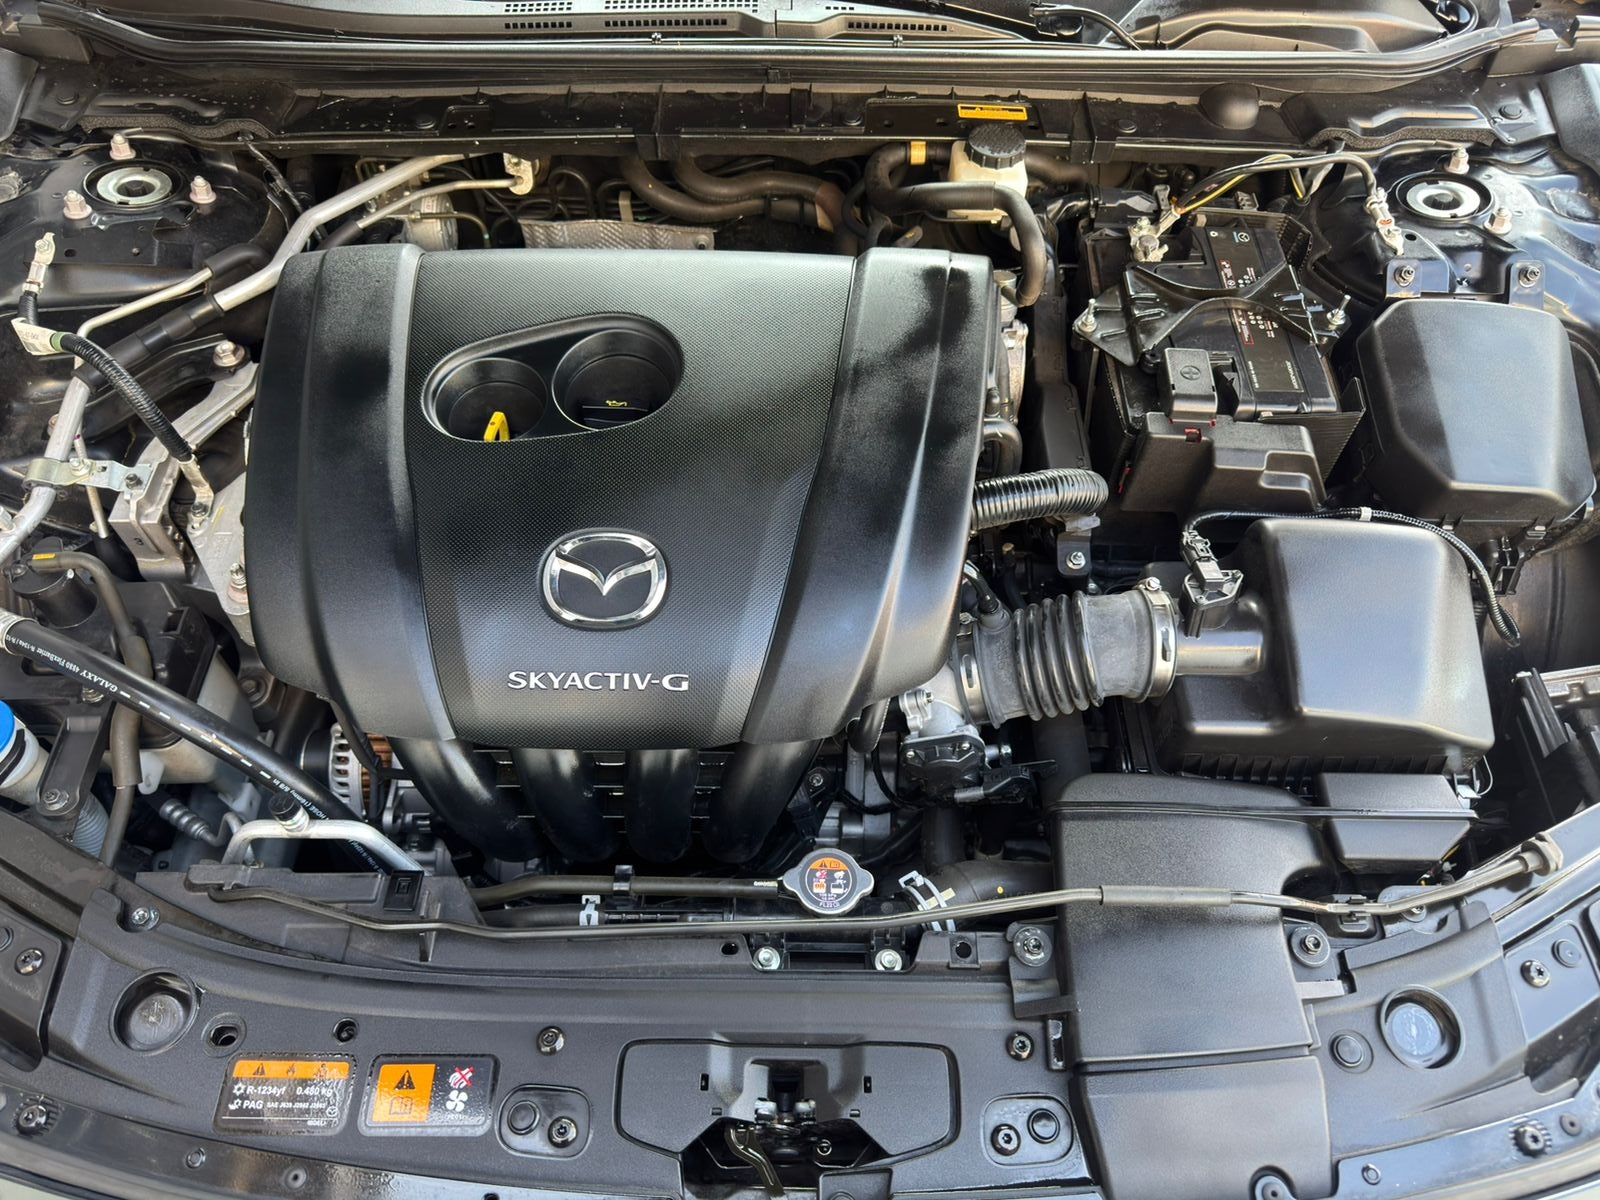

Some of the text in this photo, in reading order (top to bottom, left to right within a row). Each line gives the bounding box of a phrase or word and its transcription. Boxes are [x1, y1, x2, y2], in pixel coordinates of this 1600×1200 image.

[80, 669, 118, 693] GALAXY
[507, 671, 689, 692] SKYACTIV-G
[246, 1086, 287, 1097] R-1234yf
[320, 1086, 333, 1097] kg
[242, 1100, 264, 1110] PAG
